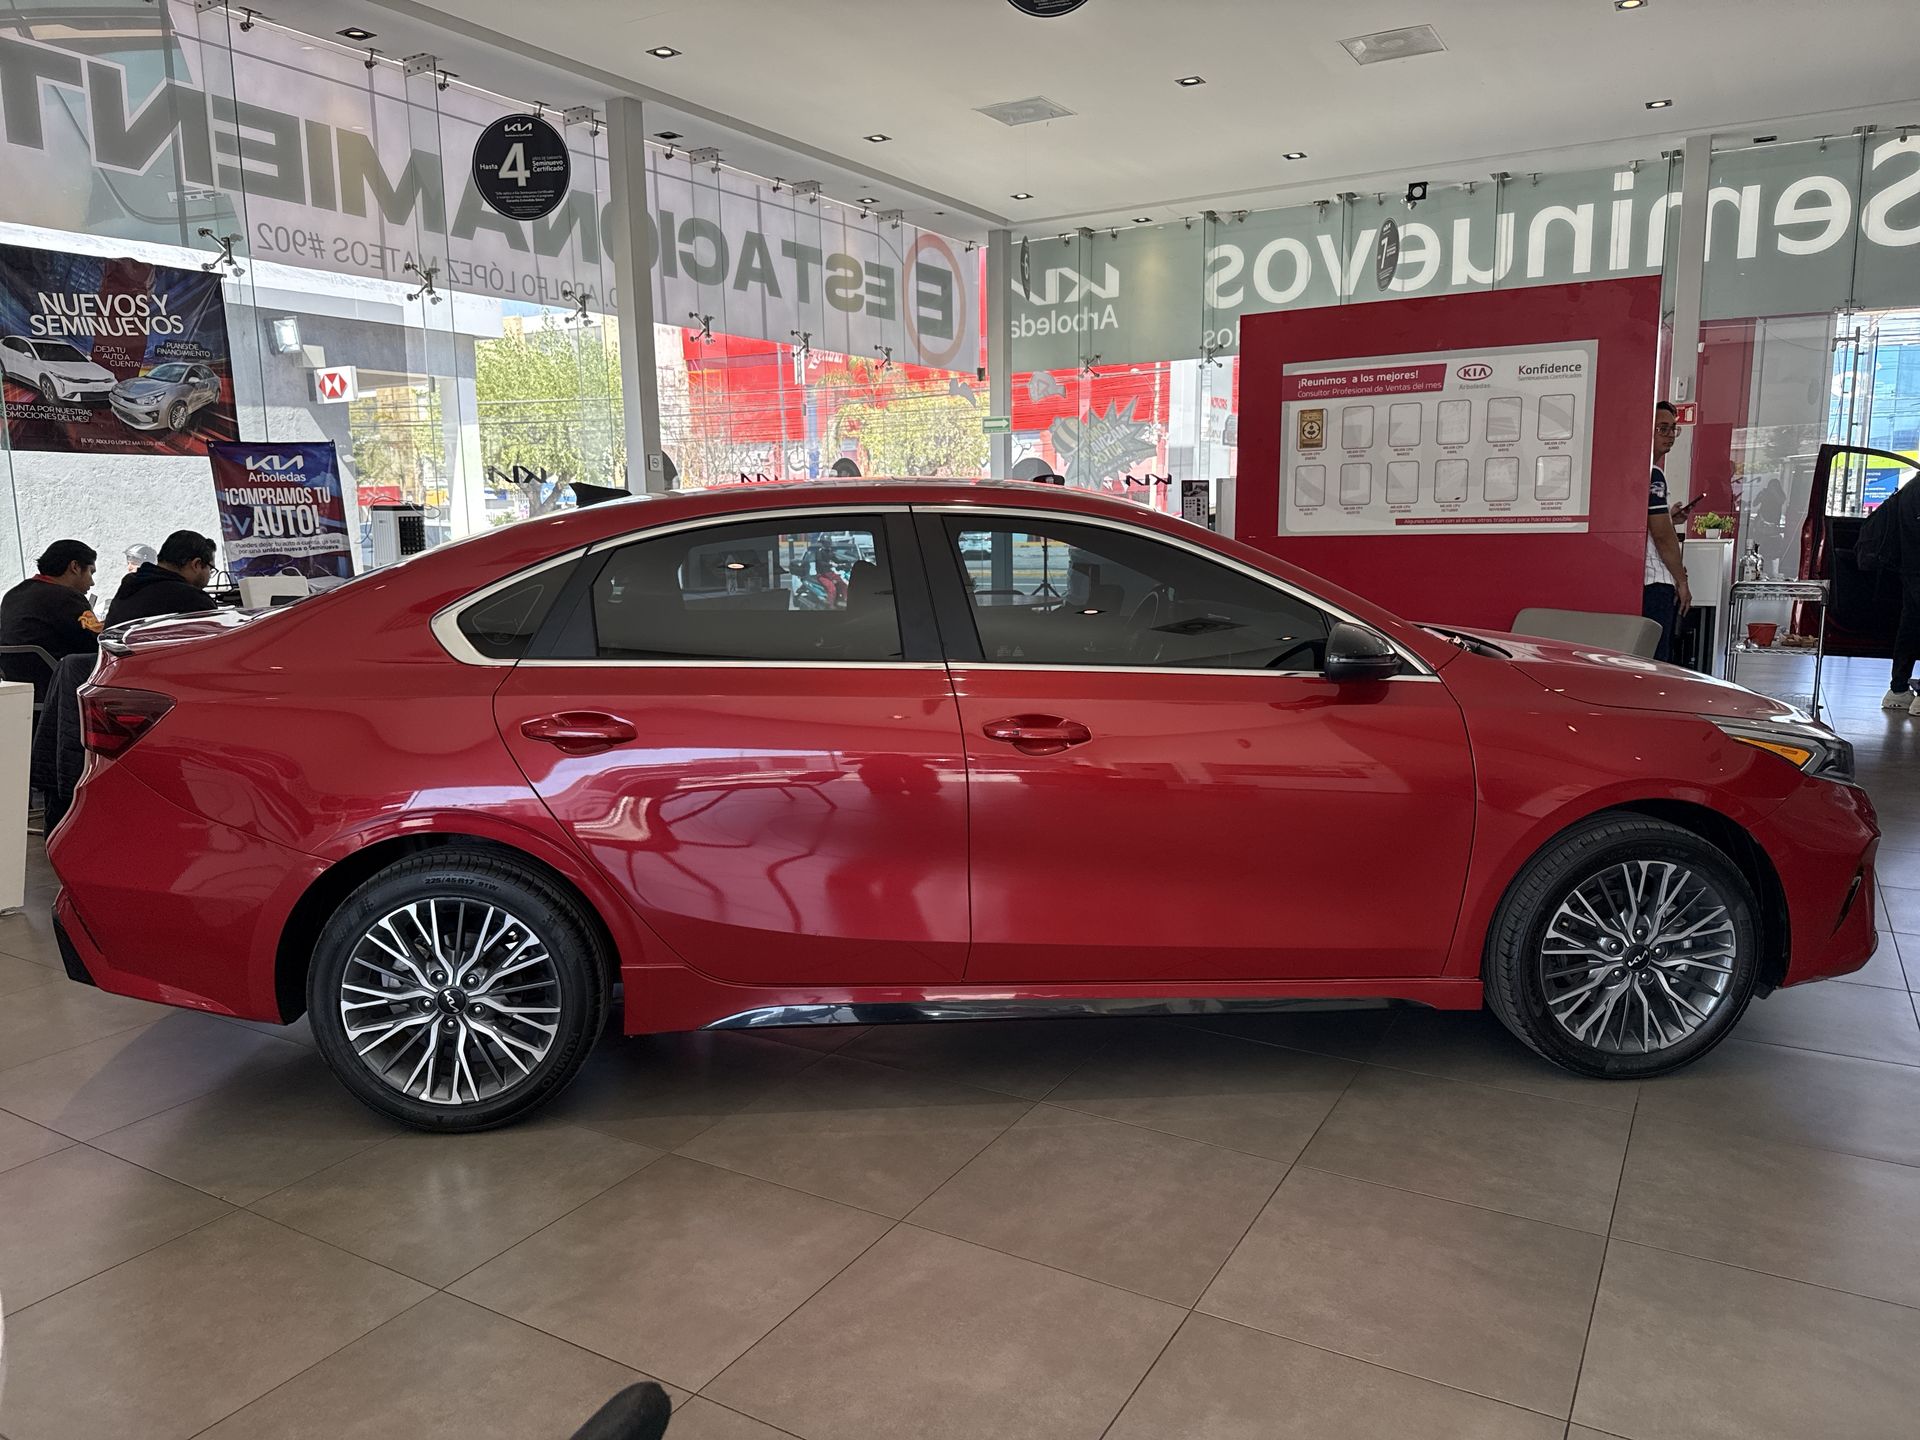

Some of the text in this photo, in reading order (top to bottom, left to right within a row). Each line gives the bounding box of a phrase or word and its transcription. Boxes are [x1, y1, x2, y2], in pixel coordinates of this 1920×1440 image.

[504, 123, 533, 132] KIA
[498, 142, 531, 187] 4
[532, 159, 563, 167] Seminuevo
[38, 292, 168, 317] NUEVOS Y
[29, 315, 184, 336] SEMINUEVOS
[115, 346, 126, 354] TU
[167, 342, 199, 351] PLANES DE
[102, 353, 124, 361] AUTO
[156, 348, 210, 358] FINANCIAMIENTO
[1463, 368, 1487, 378] KIA
[1518, 363, 1582, 376] Konfidence
[1298, 370, 1419, 389] ¡Reunimos a los mejores!
[1297, 389, 1331, 398] Consultor
[1332, 386, 1373, 396] Profesional
[1374, 385, 1383, 393] de
[1385, 383, 1411, 392] Ventas
[1413, 382, 1424, 390] del
[1458, 383, 1491, 391] Arboledas
[37, 405, 55, 413] POR
[56, 407, 93, 417] NUESTRAS
[57, 414, 72, 422] DEL
[245, 455, 304, 470] KIA
[248, 472, 306, 483] Arboledas
[225, 486, 331, 505] ¡COMPRAMOS TU
[253, 505, 320, 536] AUTO!
